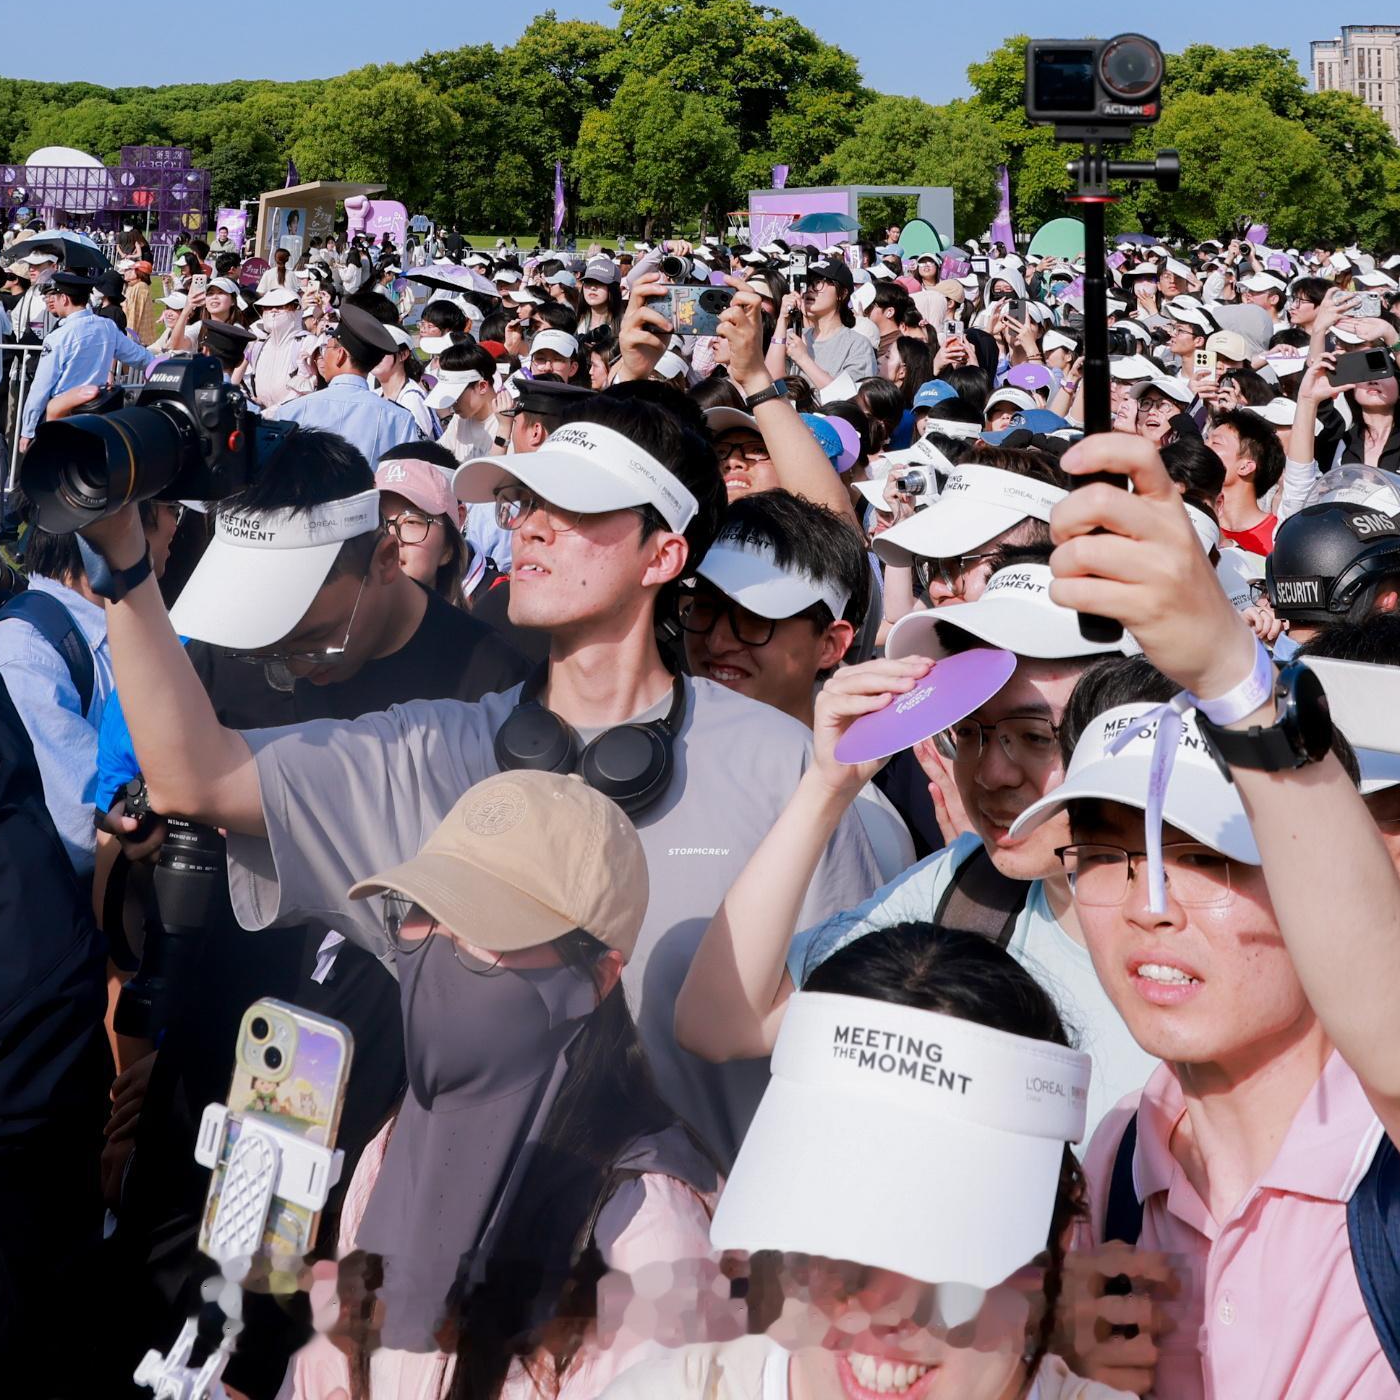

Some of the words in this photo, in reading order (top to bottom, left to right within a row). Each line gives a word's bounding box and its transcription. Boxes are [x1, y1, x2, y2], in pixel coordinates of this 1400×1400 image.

[149, 372, 180, 383] Nikon
[1352, 513, 1396, 534] SMS
[226, 527, 276, 542] MOMENT
[1276, 580, 1319, 605] SECURITY
[667, 847, 730, 856] STORMCREW
[833, 1025, 943, 1063] MEETING
[833, 1046, 856, 1060] THE
[858, 1050, 973, 1094] MOMENT
